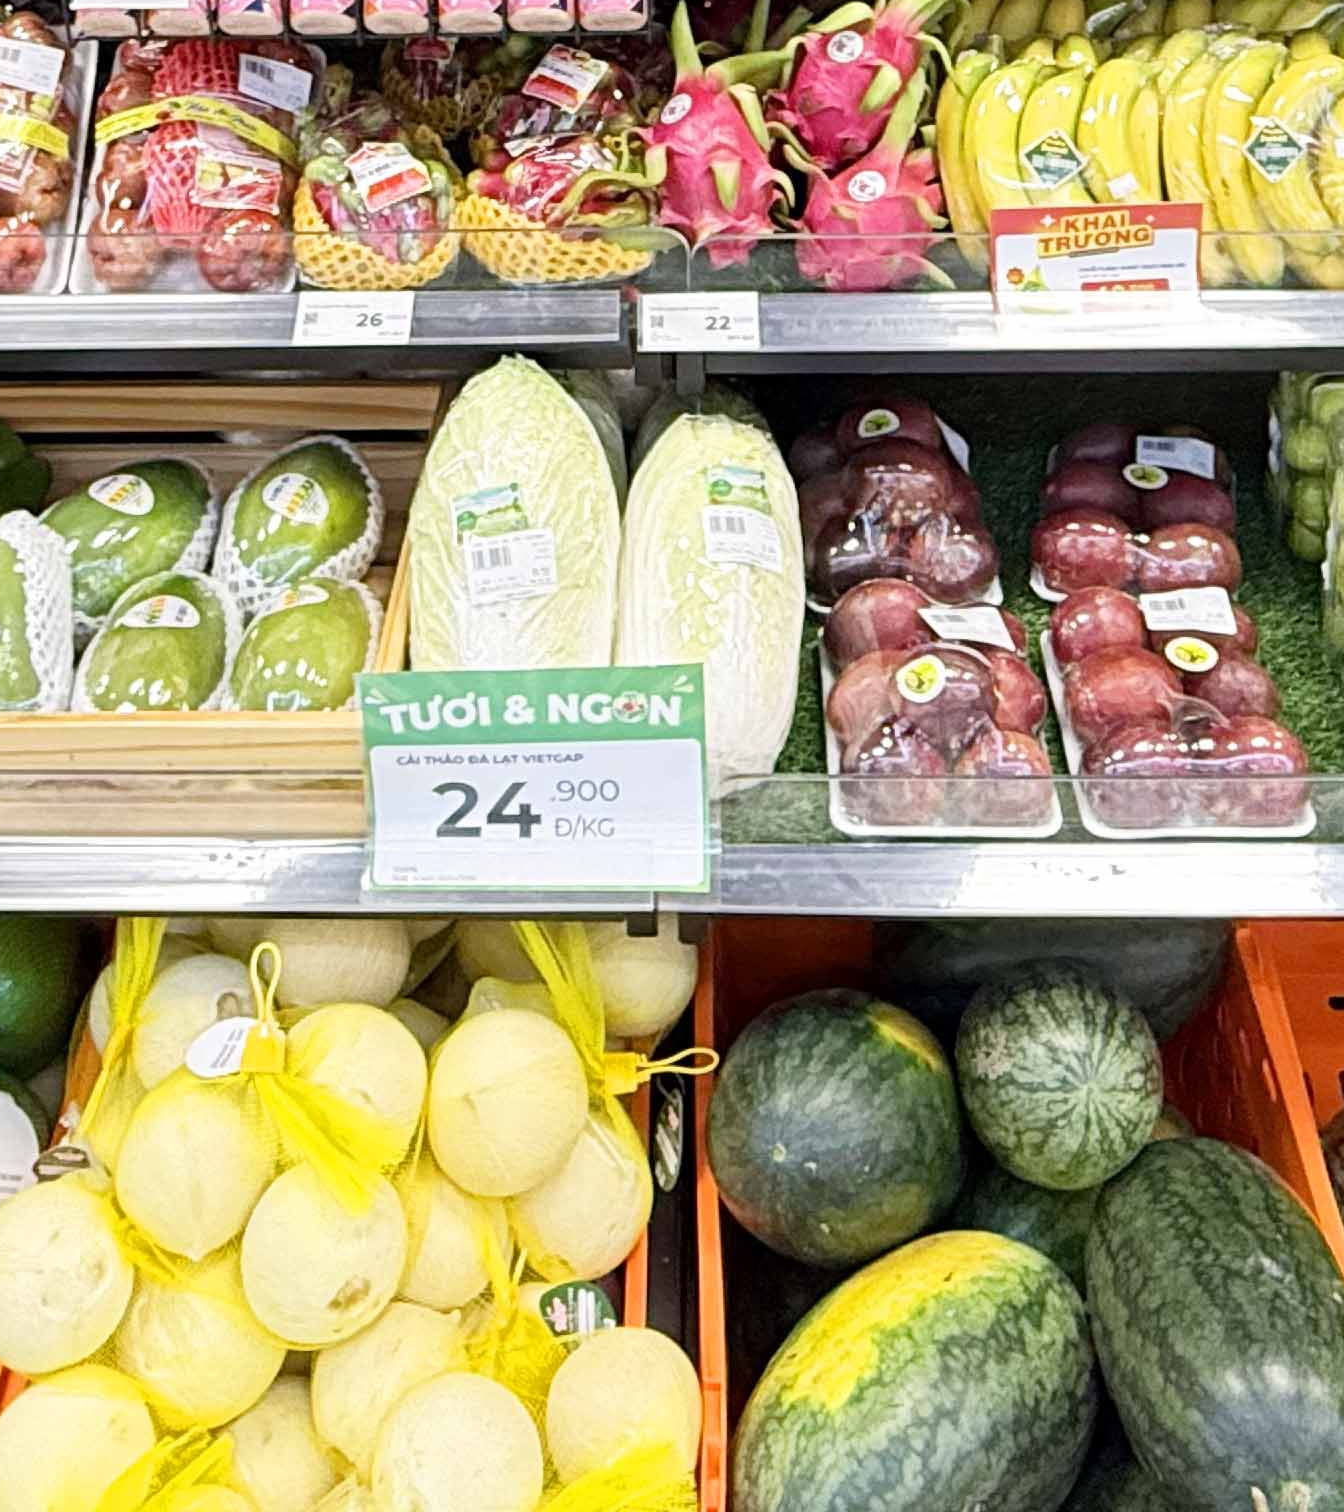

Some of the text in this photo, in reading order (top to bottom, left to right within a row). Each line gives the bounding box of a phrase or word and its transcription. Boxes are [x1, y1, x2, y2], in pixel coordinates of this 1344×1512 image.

[1065, 213, 1127, 234] KHAI
[1039, 226, 1151, 253] TRƯƠNG
[356, 312, 383, 327] 26
[704, 315, 731, 330] 22
[379, 691, 683, 735] TƯƠI & NGON
[432, 781, 541, 838] 24
[554, 817, 616, 838] Đ/KG
